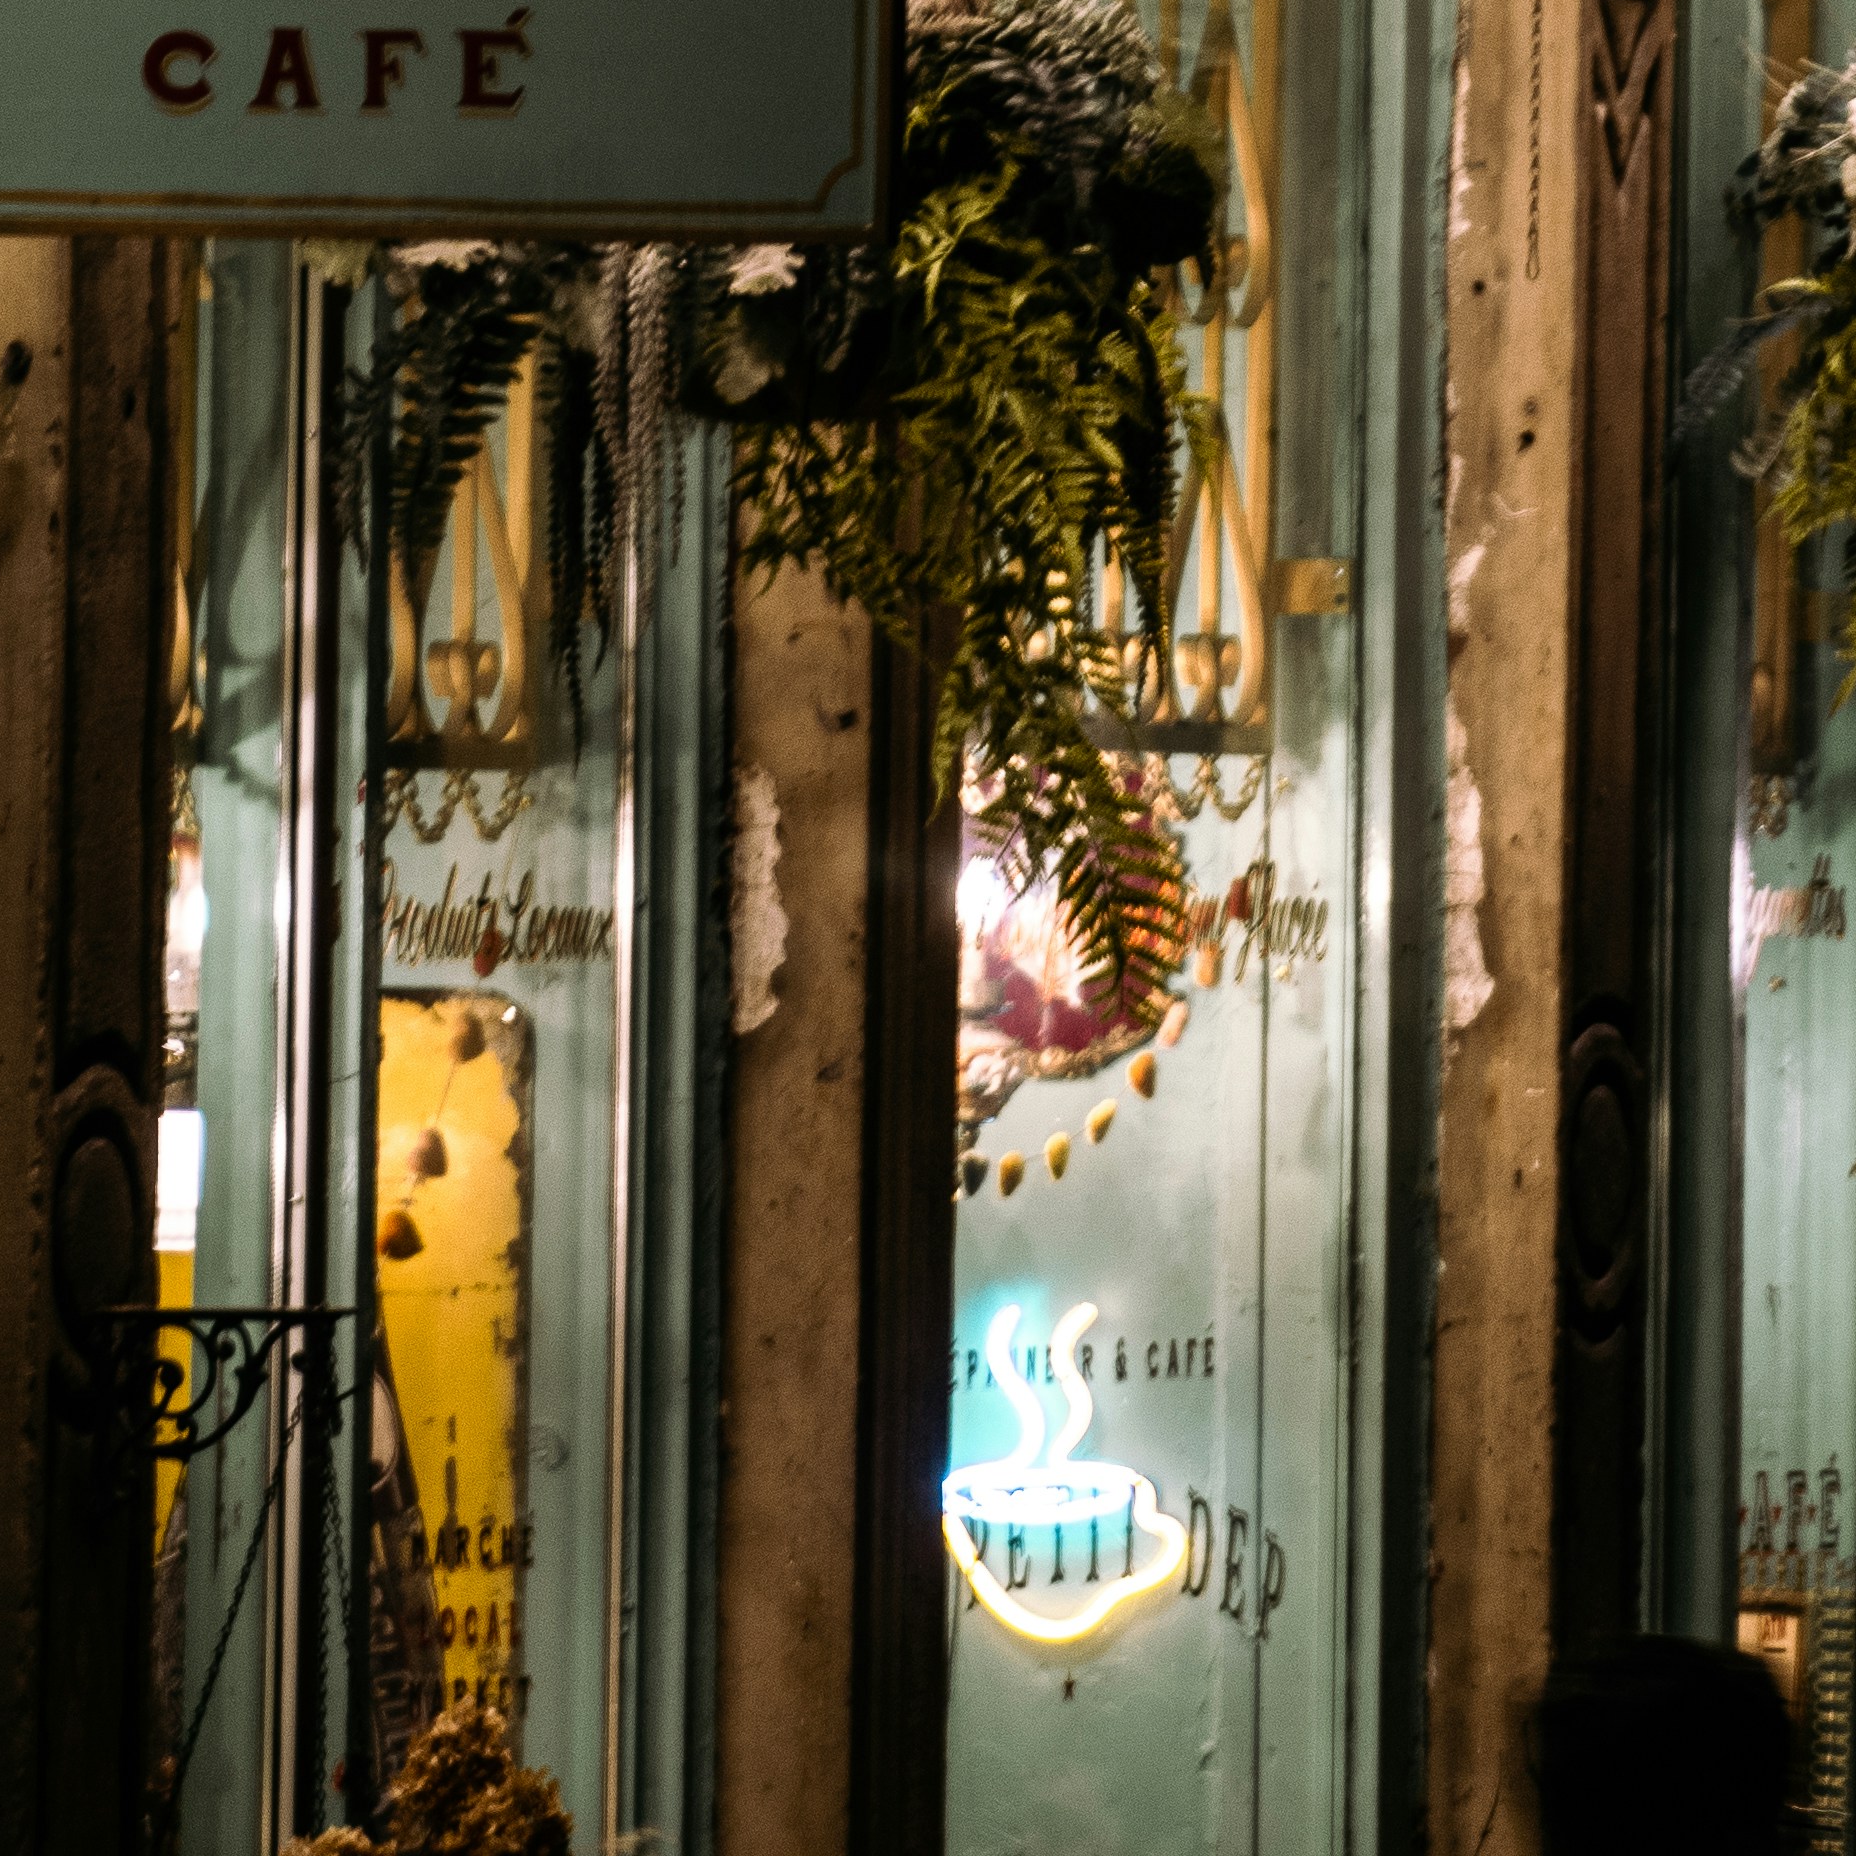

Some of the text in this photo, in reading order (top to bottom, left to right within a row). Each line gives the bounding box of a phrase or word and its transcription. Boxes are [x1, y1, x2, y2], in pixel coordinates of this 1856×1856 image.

[141, 6, 535, 115] CAFÉ
[1147, 1320, 1215, 1380] CAFÉ
[1745, 1450, 1842, 1557] AFÉ
